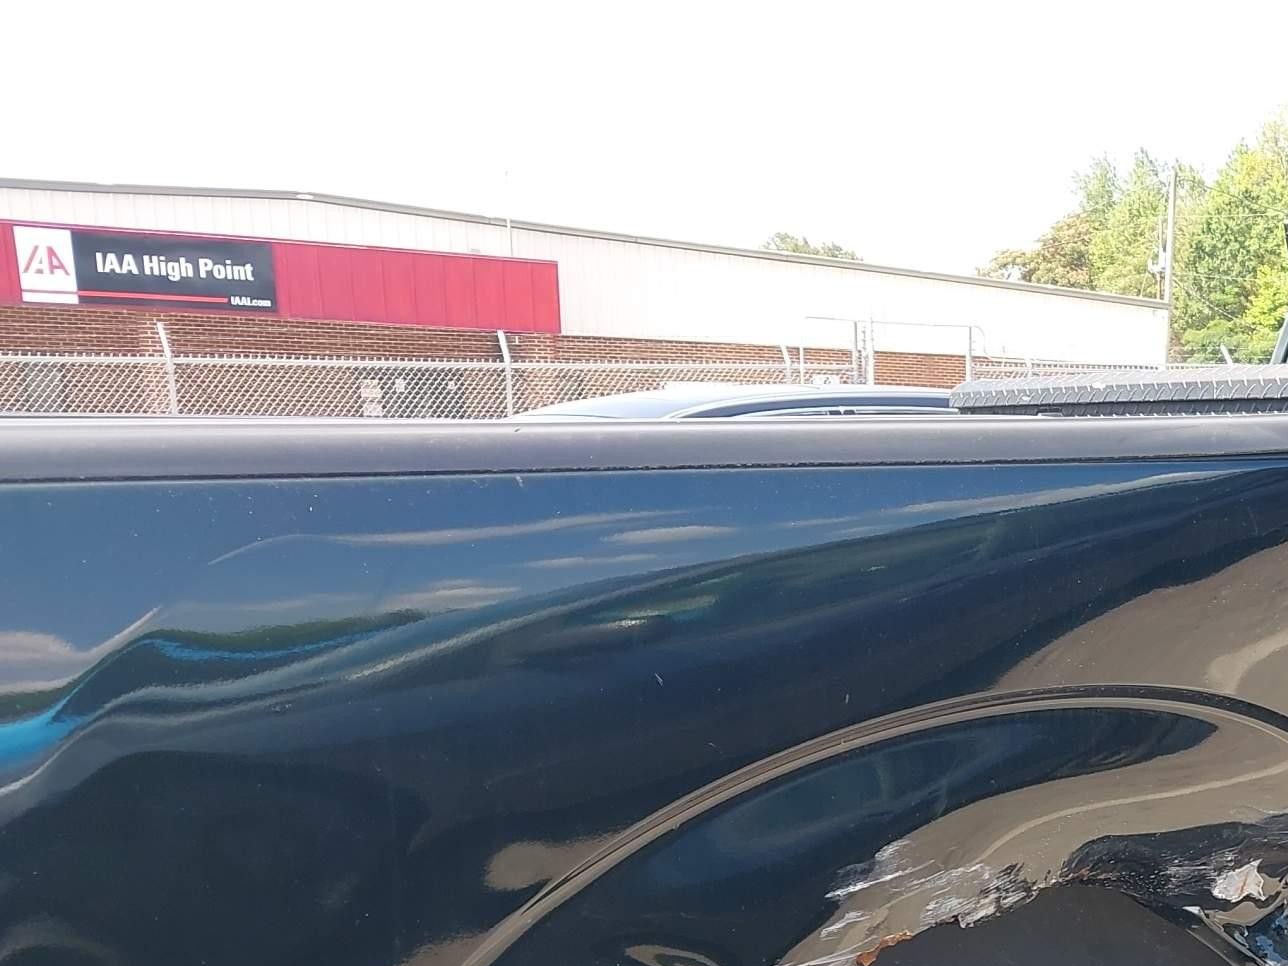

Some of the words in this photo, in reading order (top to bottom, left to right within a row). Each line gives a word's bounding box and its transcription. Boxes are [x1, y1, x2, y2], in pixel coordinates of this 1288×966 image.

[95, 252, 140, 275] IAA
[142, 255, 194, 282] High
[198, 257, 255, 281] Point
